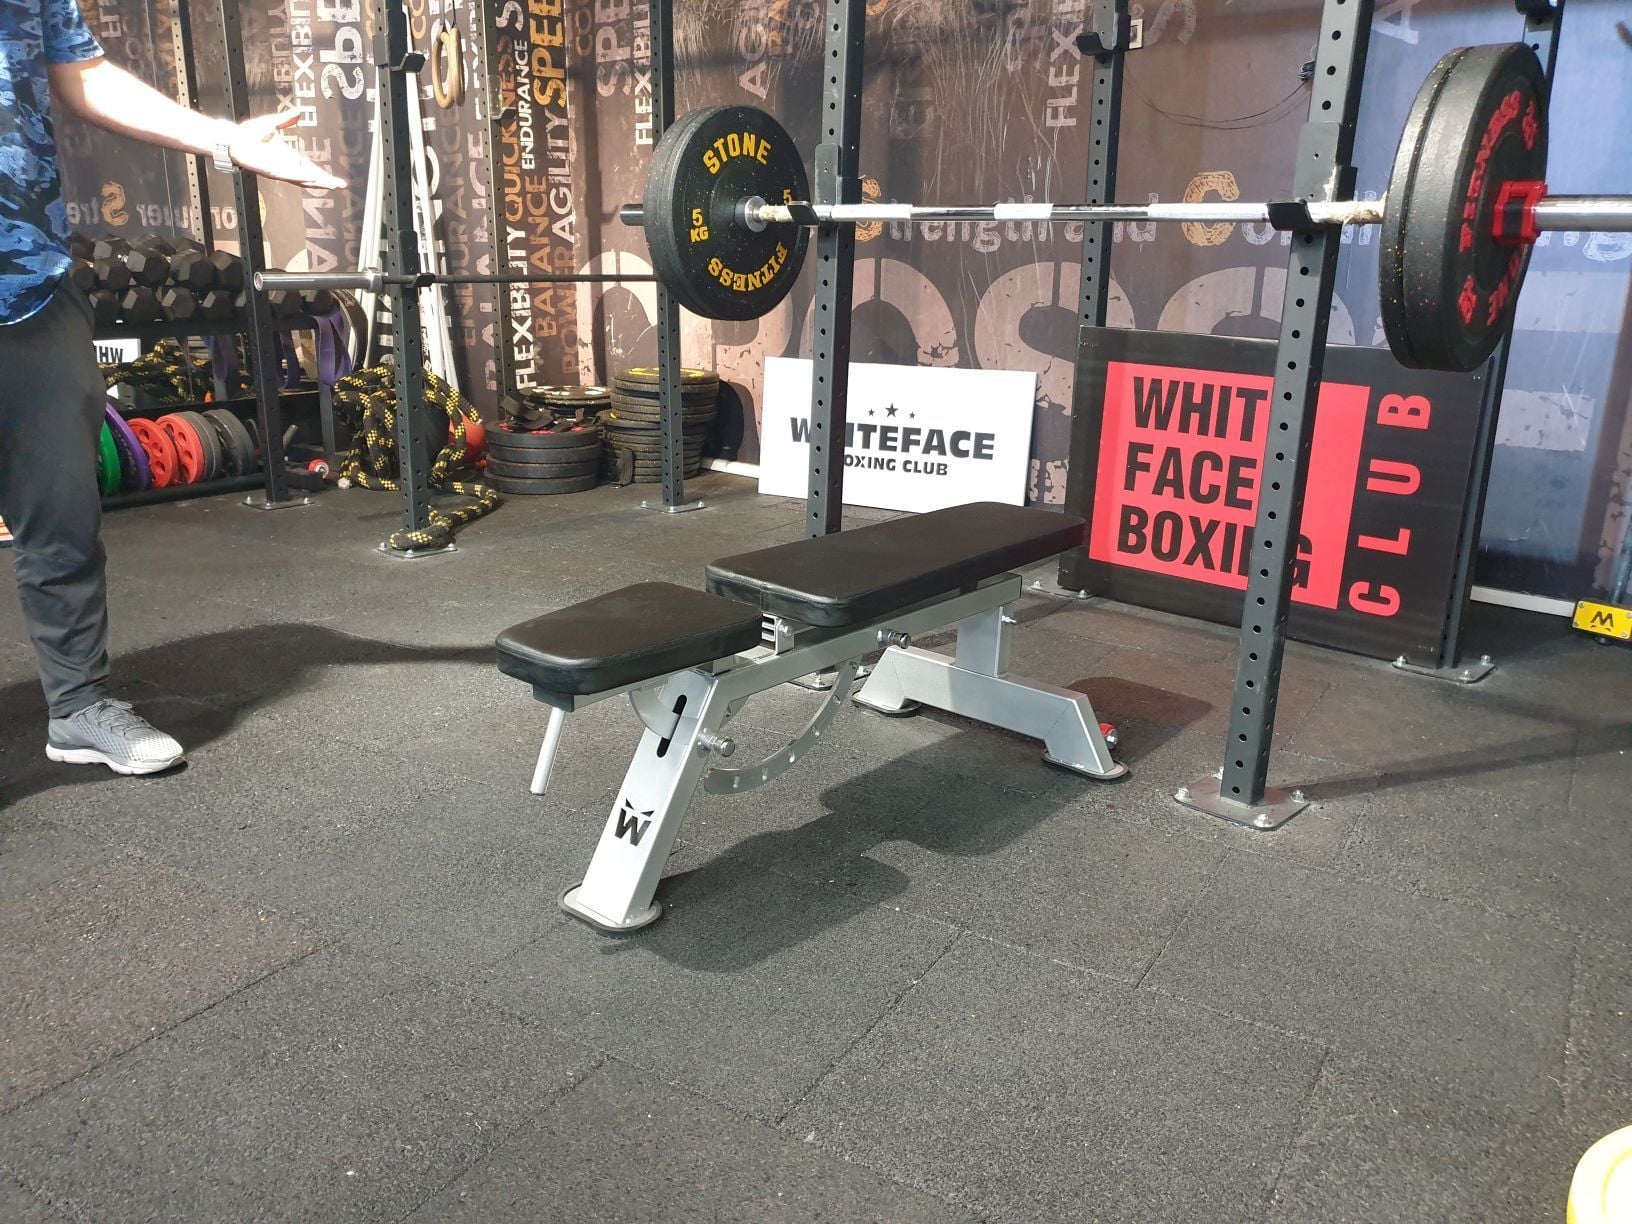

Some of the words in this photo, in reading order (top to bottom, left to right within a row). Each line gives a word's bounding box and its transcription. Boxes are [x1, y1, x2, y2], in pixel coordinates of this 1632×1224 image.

[513, 39, 536, 170] ENDURANCE
[544, 107, 577, 243] AGILITY
[703, 131, 772, 175] STONE
[690, 226, 709, 242] KG
[692, 207, 702, 226] 5
[708, 241, 788, 292] FITNESS
[1133, 376, 1269, 442] WHIT
[790, 416, 996, 461] WITEFACE
[842, 453, 897, 472] OXING
[902, 459, 948, 476] CLUB
[1123, 441, 1258, 511] FACE
[1348, 392, 1432, 618] CLUB
